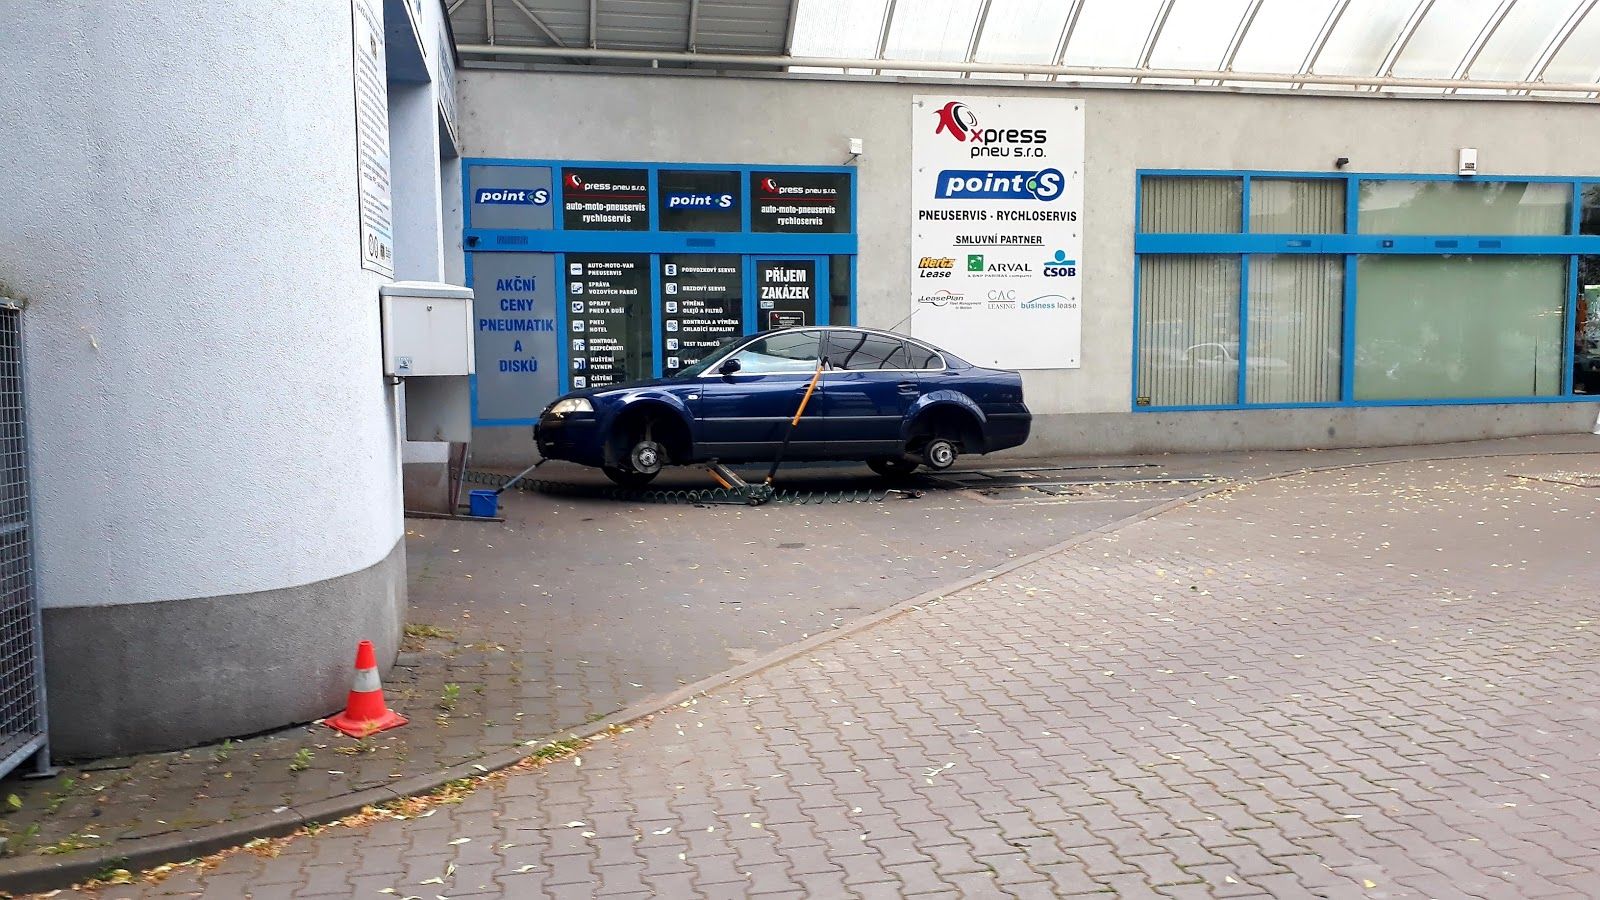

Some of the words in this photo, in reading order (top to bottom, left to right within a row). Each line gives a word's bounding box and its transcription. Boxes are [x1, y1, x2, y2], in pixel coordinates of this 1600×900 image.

[970, 146, 1010, 158] pneu
[1013, 147, 1047, 158] s.r.o.
[946, 173, 1024, 196] point
[1037, 173, 1060, 197] S
[480, 190, 526, 203] point
[534, 190, 548, 204] S
[670, 194, 712, 207] point
[719, 194, 732, 208] S
[566, 201, 646, 213] auto-moto-pneuservis
[761, 204, 836, 215] auto-moto-pneuservis
[582, 213, 632, 223] rychloservis
[777, 216, 823, 226] rychloservis
[918, 210, 987, 221] PNEUSERVIS
[996, 211, 1077, 222] RYCHLOSERVIS
[955, 233, 998, 245] SMLUVNÍ
[1000, 235, 1042, 245] PARTNER
[918, 257, 956, 269] Hertz
[987, 263, 1033, 272] ARVAL
[765, 268, 807, 283] PŘÍJEM
[920, 270, 952, 278] Lease
[496, 275, 537, 292] AKČNÍ
[761, 284, 810, 300] ZAKÁZEK
[987, 289, 1016, 300] CAC
[500, 299, 534, 311] CENY
[480, 319, 554, 332] PNEUMATIK
[514, 340, 522, 352] A
[500, 357, 538, 373] DISKŮ
